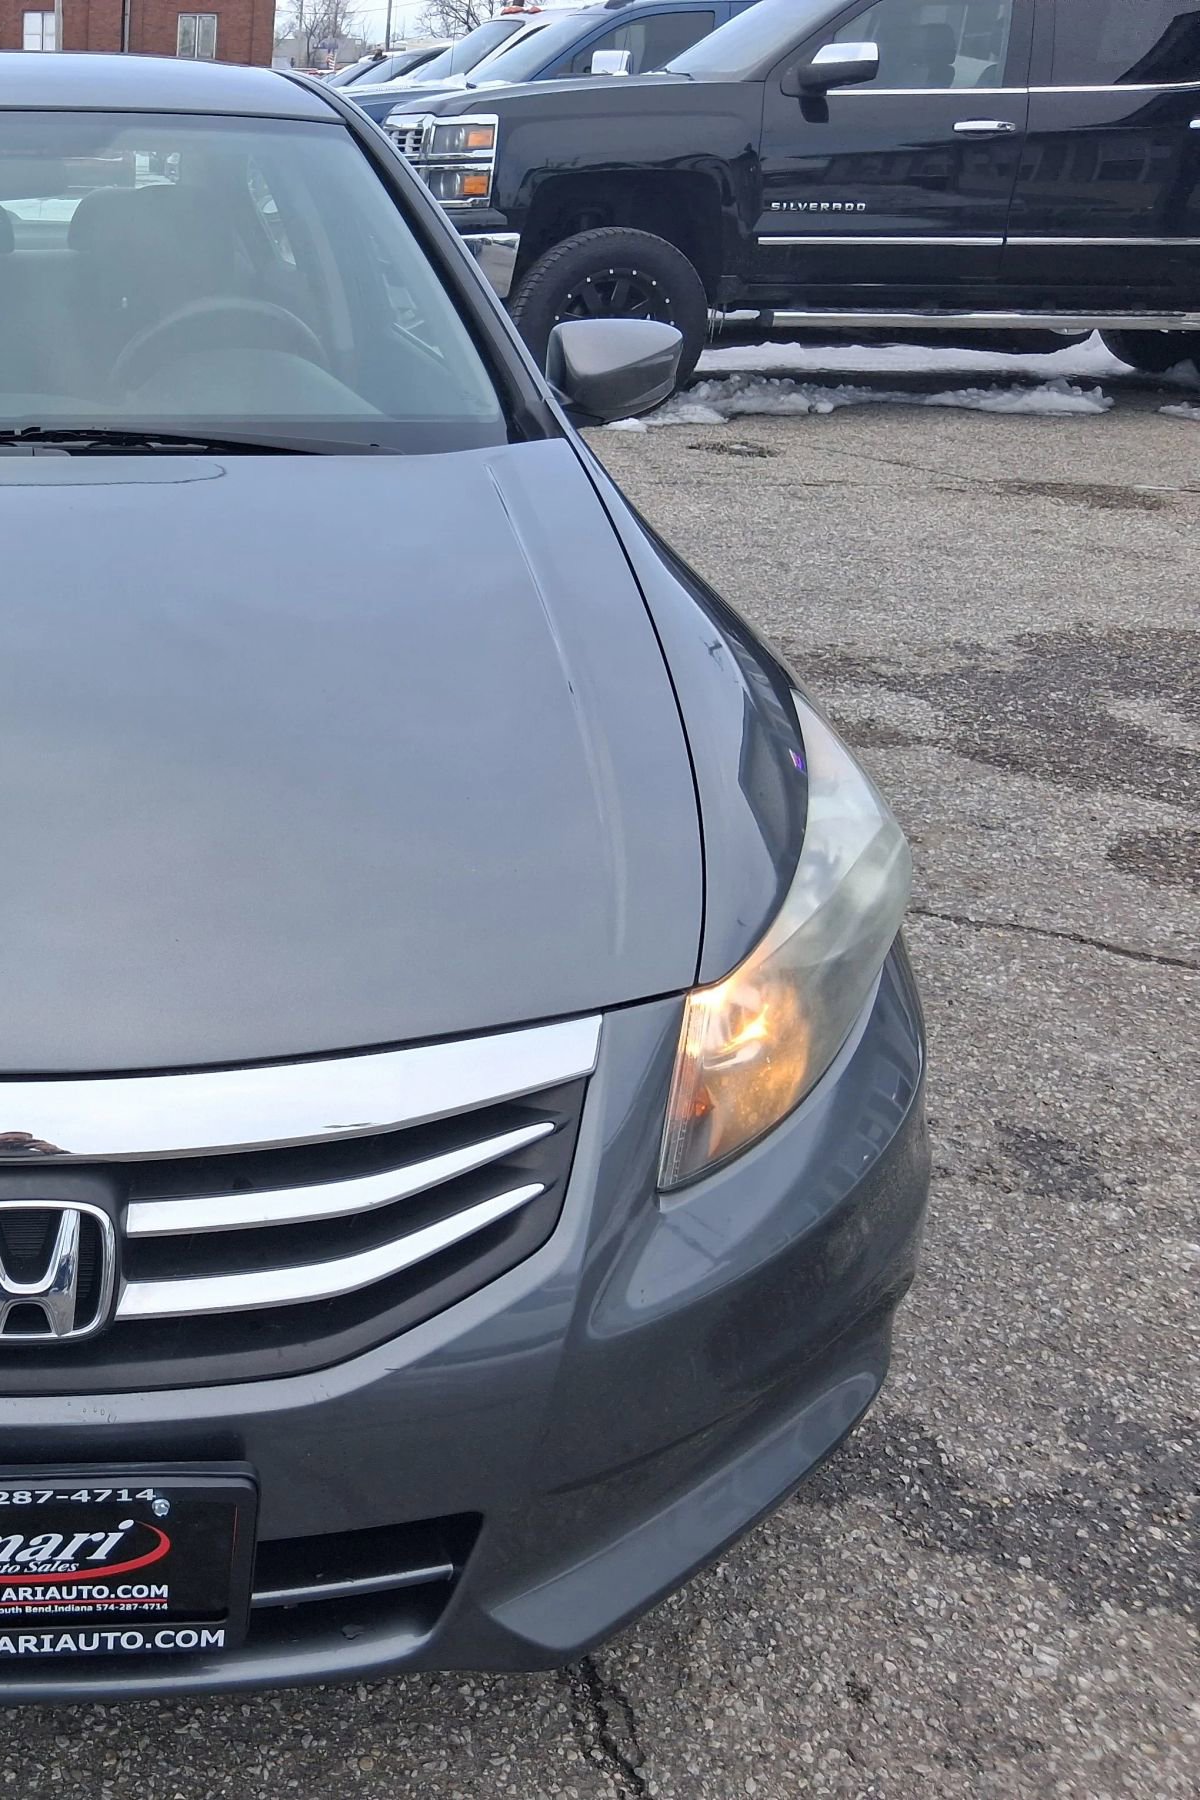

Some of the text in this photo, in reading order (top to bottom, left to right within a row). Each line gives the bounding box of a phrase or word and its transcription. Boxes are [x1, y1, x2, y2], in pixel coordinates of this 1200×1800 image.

[770, 202, 867, 211] SILVERADO
[23, 1560, 80, 1573] Sales
[96, 1603, 169, 1611] 574-287-4714
